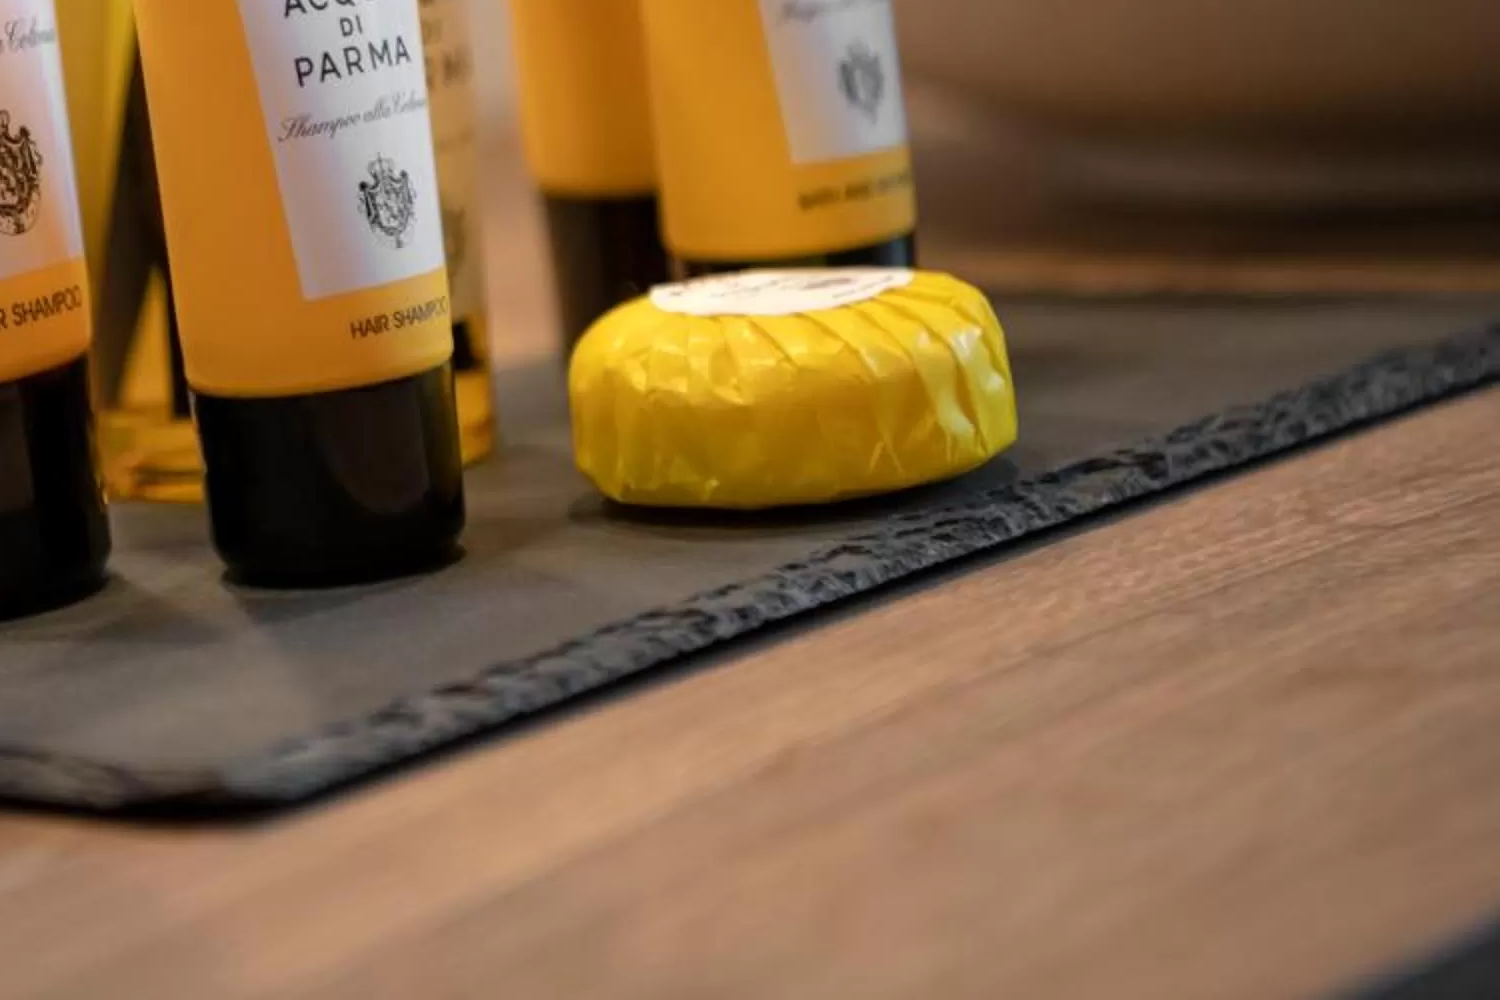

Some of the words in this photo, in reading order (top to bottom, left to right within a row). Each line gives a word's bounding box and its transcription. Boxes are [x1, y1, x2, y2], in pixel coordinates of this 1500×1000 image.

[339, 14, 363, 37] DI
[293, 35, 412, 88] PARMA
[276, 111, 361, 143] Shampoo
[349, 313, 391, 340] HAIR
